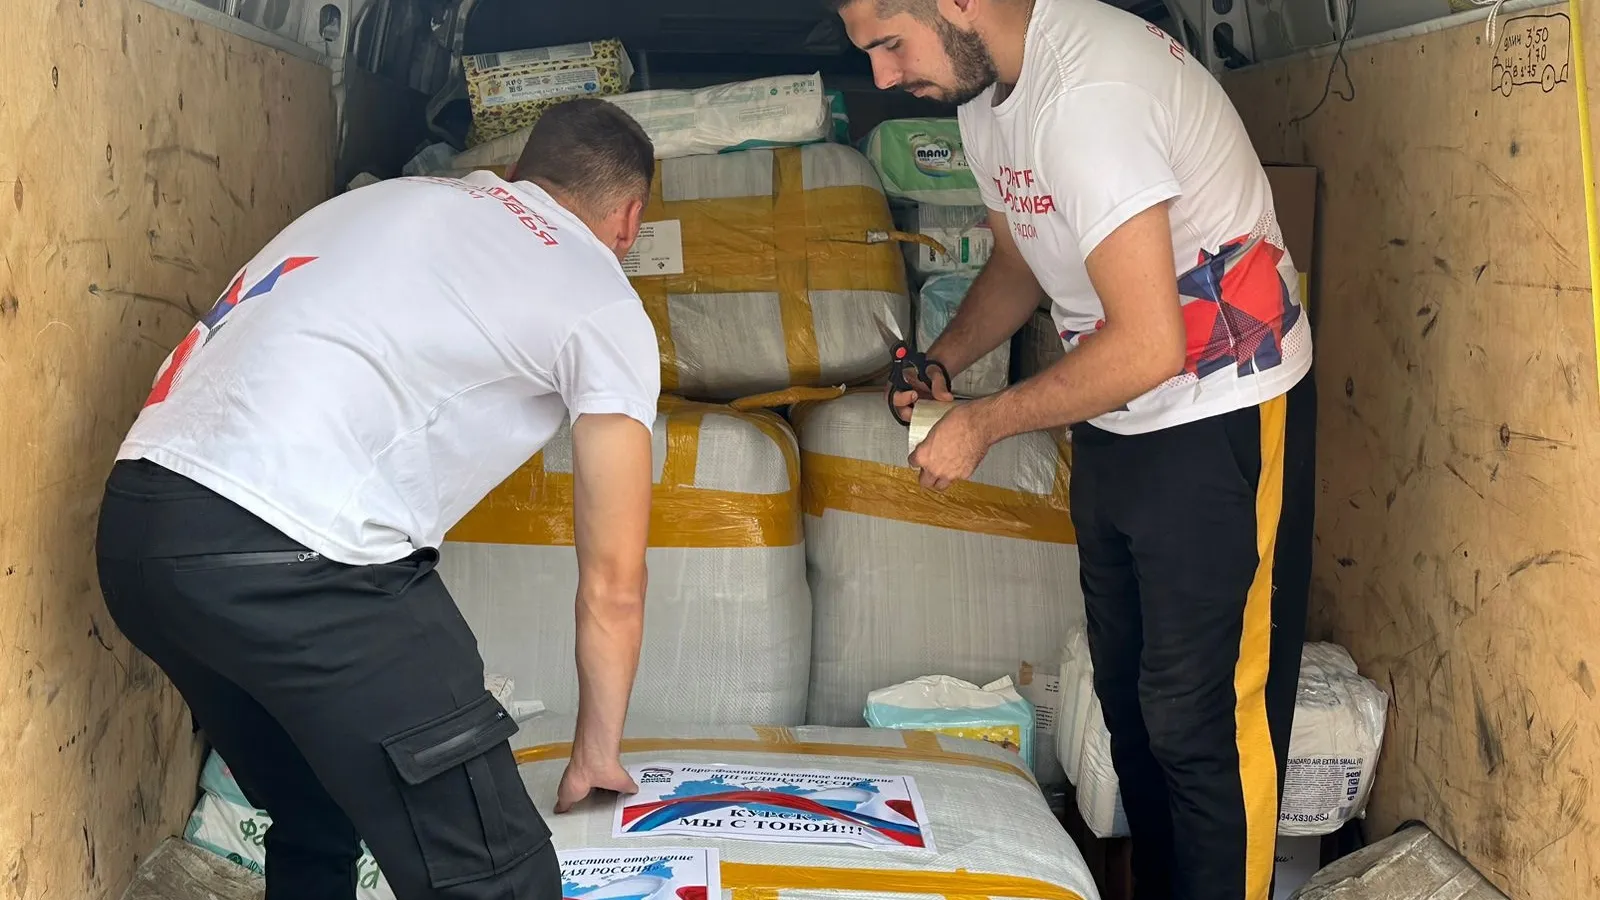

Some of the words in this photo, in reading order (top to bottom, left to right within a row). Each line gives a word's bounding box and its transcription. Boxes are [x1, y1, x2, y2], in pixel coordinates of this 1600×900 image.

[917, 149, 949, 158] MANU
[1312, 758, 1322, 766] AIR
[1322, 758, 1339, 766] EXTRA
[1340, 758, 1356, 766] SMALL
[681, 766, 779, 777] Наро-Фоминское
[781, 771, 831, 779] местное
[833, 775, 894, 784] отделение
[679, 818, 725, 828] МЫ
[730, 819, 747, 829] С
[753, 819, 863, 836] ТОБОЙ!!!
[561, 858, 621, 866] местное
[623, 854, 694, 866] отделение
[561, 868, 586, 877] АЯ
